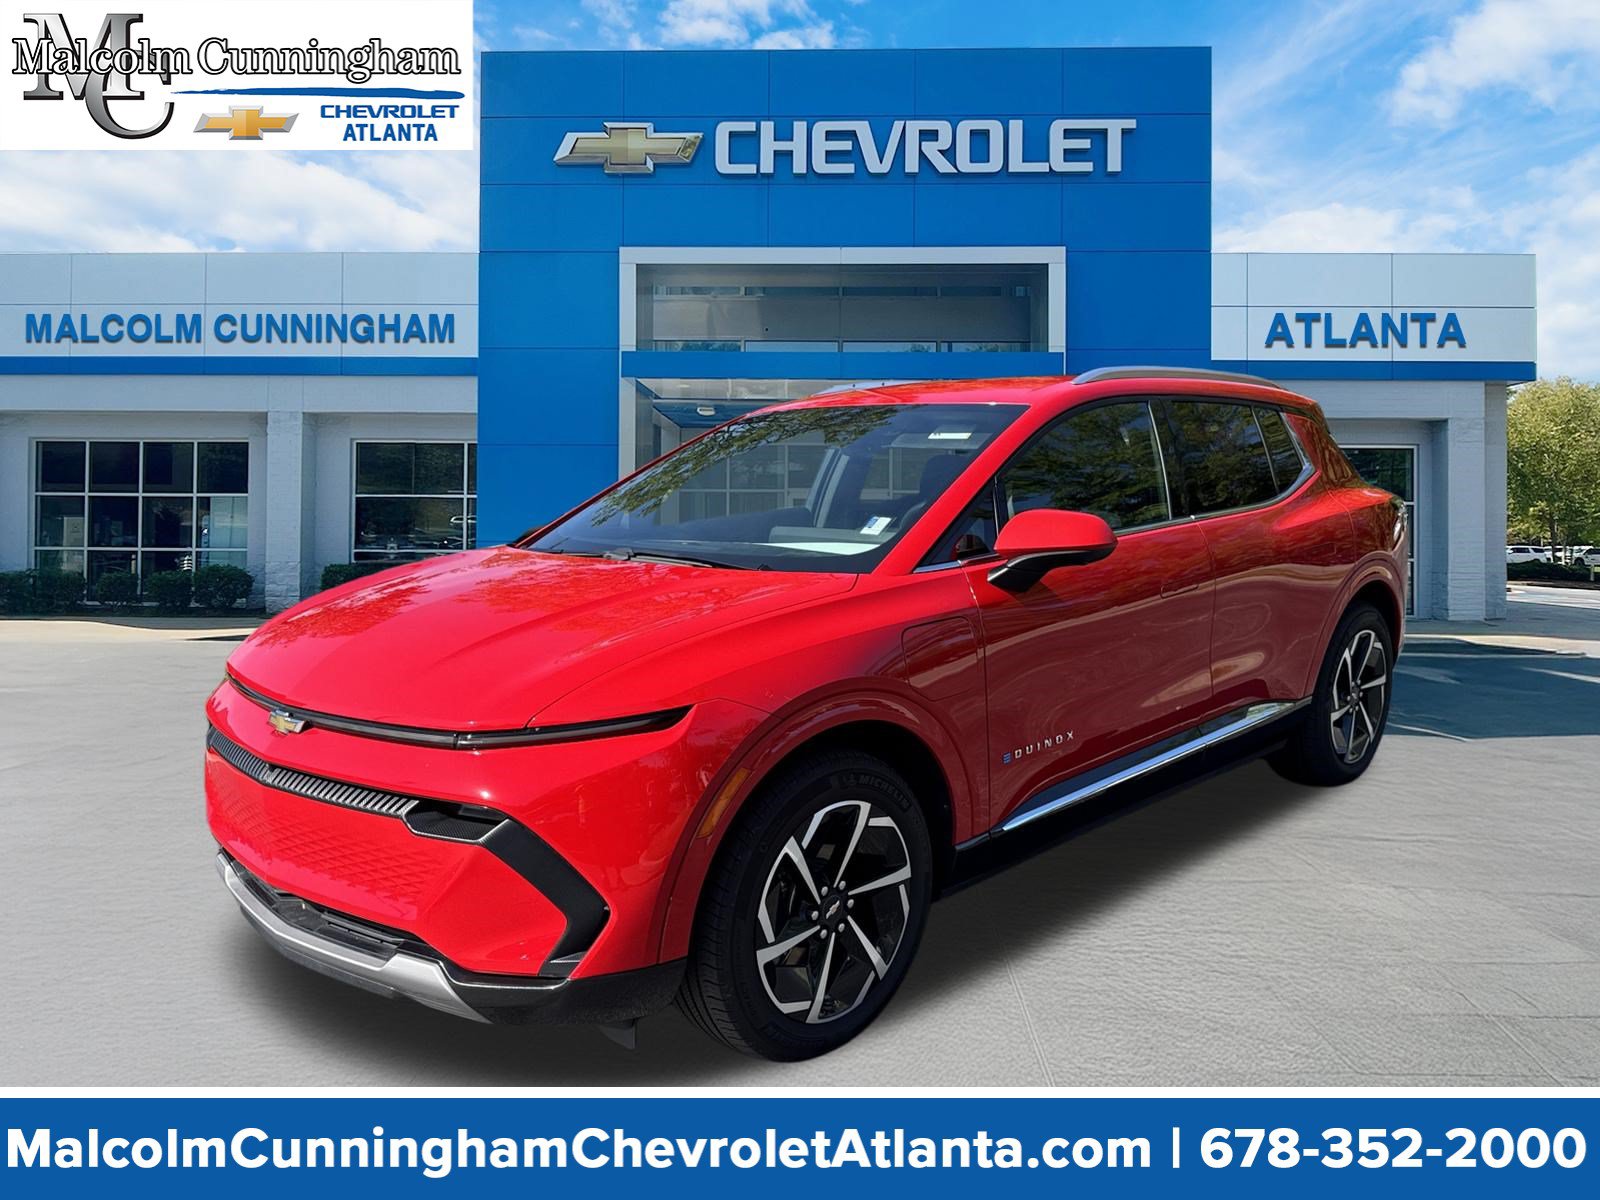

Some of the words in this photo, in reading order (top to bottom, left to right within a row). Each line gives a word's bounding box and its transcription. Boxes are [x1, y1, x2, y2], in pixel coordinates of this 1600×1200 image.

[714, 119, 1137, 175] CHEVROLET
[25, 313, 202, 344] MALCOLM
[213, 313, 455, 344] CUNNINGHAM
[1264, 312, 1467, 349] ATLANTA
